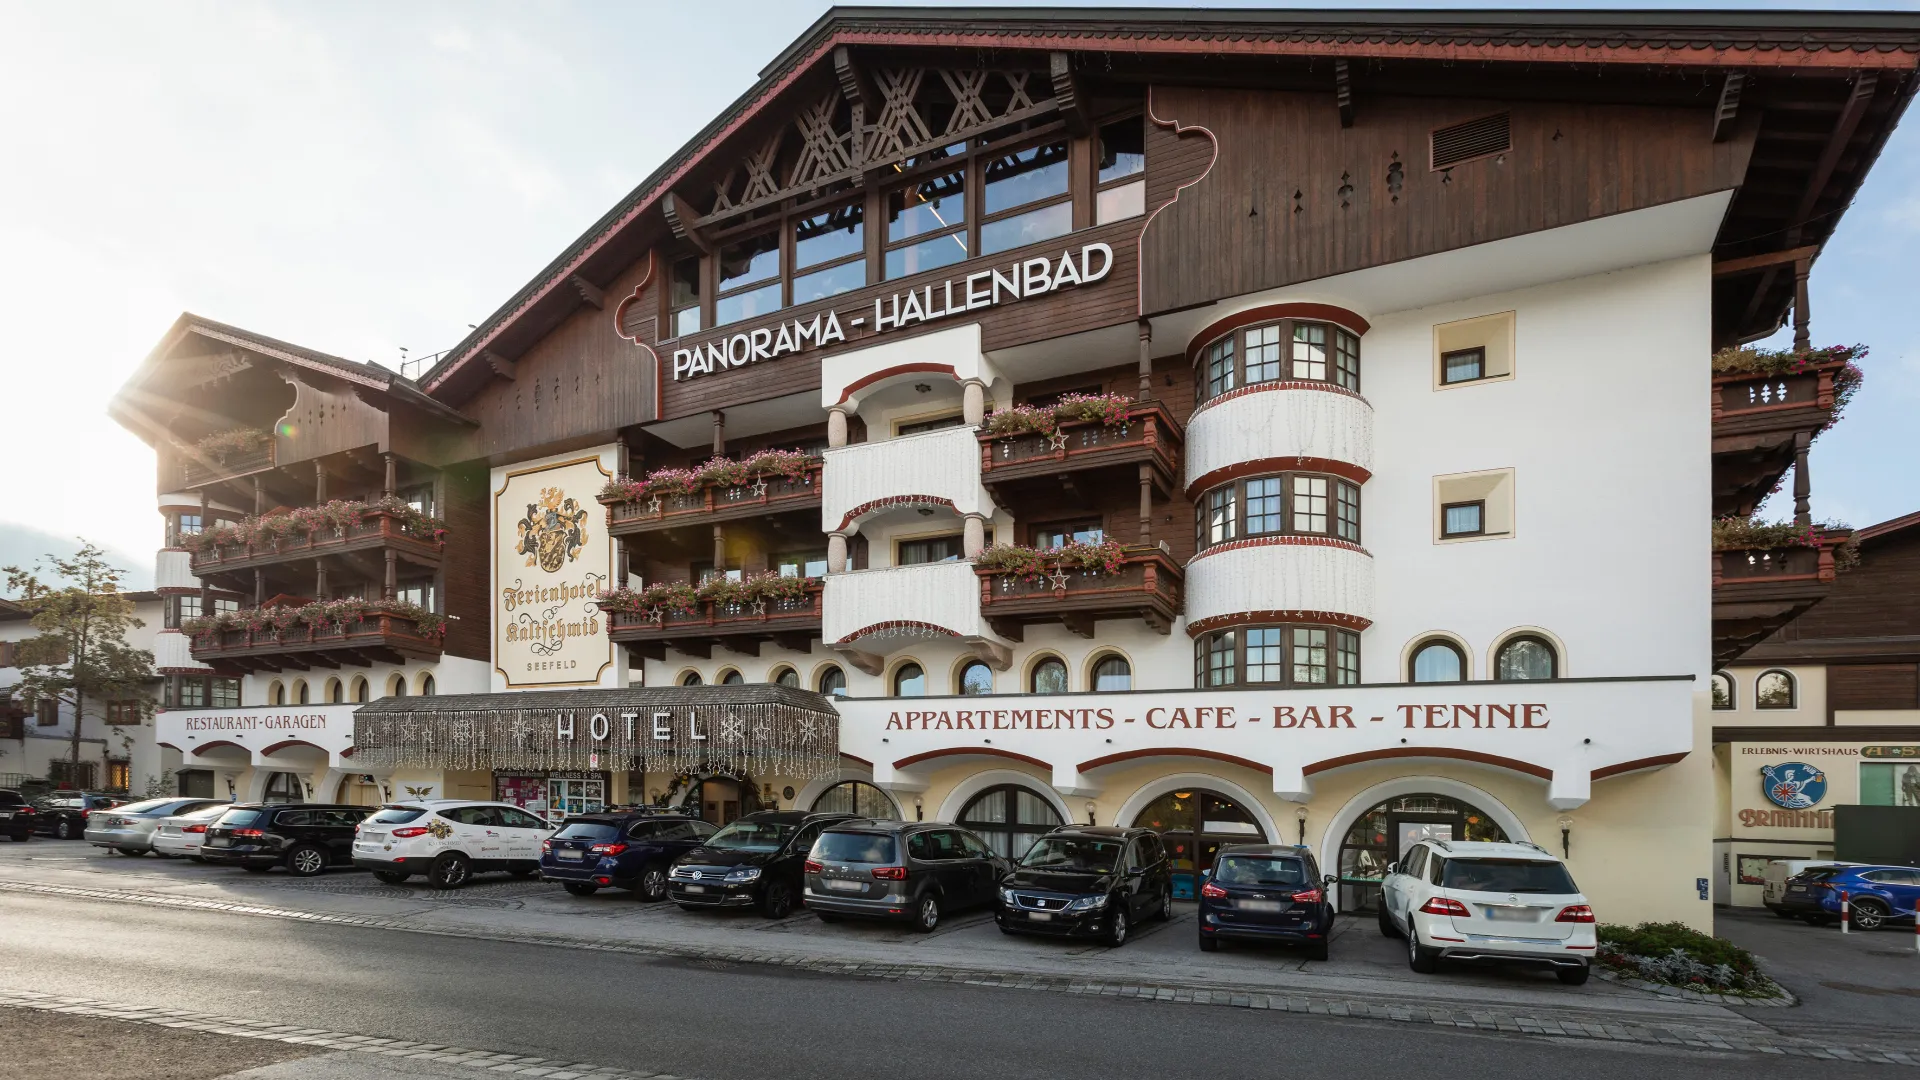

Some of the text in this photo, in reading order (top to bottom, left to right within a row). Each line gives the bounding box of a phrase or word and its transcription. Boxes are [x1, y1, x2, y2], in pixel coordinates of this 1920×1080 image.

[673, 309, 846, 381] PANORAMA
[875, 242, 1115, 333] HALLENBAD
[503, 573, 606, 612] Ferienhotel
[506, 609, 599, 650] Kaltschmid
[527, 660, 577, 671] SEEFELD
[557, 711, 706, 741] HOTEL
[885, 708, 1115, 730] APPARTEMENTS
[1145, 707, 1237, 729] CAFE
[1273, 706, 1357, 729] BAR
[1397, 704, 1550, 729] TENNE
[1802, 765, 1817, 775] PUB
